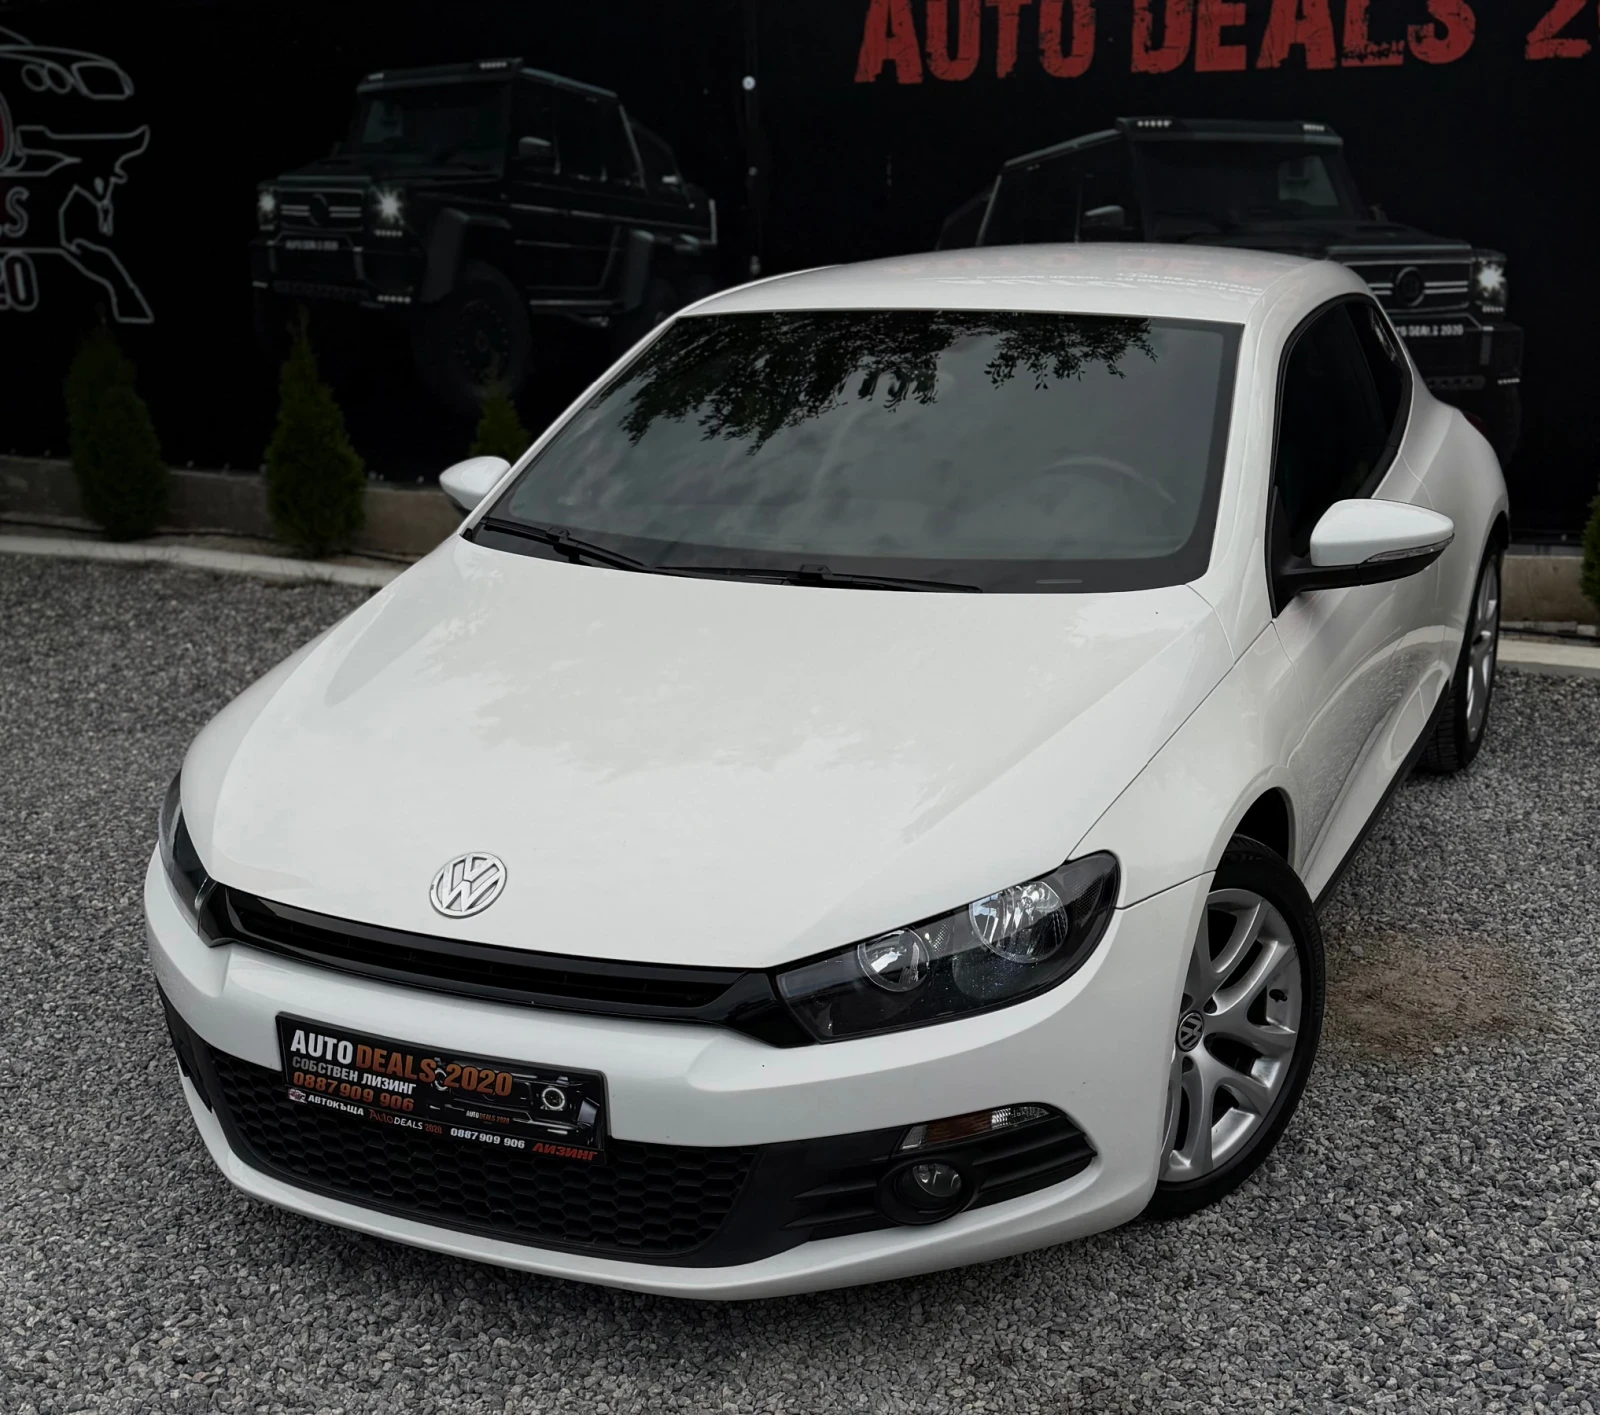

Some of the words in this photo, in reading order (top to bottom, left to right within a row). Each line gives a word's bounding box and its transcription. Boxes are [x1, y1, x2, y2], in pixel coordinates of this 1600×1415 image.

[854, 0, 1096, 84] AUTO
[1131, 0, 1476, 74] DEALS
[290, 1029, 354, 1065] AUTO
[355, 1044, 437, 1083] DEALS
[443, 1063, 513, 1096] 2020
[292, 1056, 359, 1083] СОБСТВЕН
[361, 1072, 417, 1095] ЛИЗИНГ
[293, 1071, 338, 1094] 0887
[339, 1082, 374, 1104] 909
[380, 1092, 415, 1113] 906
[307, 1094, 365, 1116] АВТОКЪЩА
[424, 1123, 443, 1135] 2020
[503, 1137, 526, 1149] 906
[532, 1142, 599, 1161] ЛИЗИНГ
